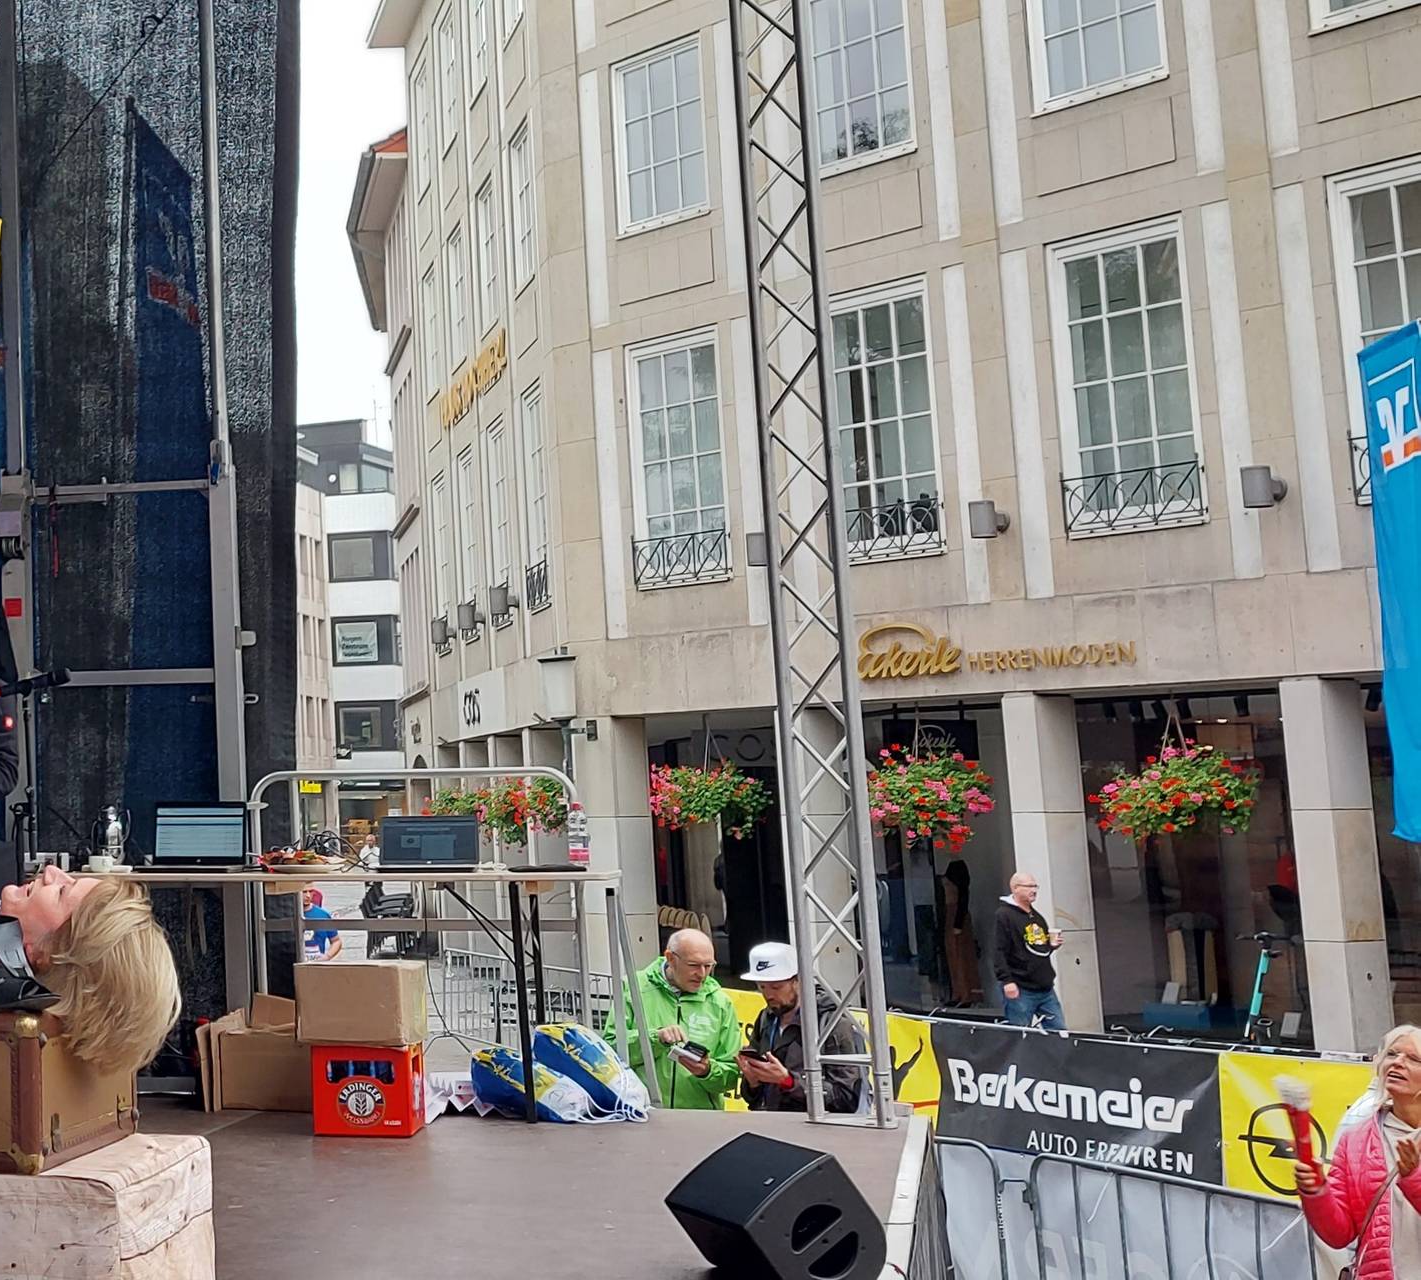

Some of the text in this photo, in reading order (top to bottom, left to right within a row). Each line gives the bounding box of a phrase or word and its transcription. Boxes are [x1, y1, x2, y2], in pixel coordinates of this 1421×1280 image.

[966, 640, 1138, 674] HERRENMODEN
[339, 1082, 383, 1103] ERDINGER
[947, 1057, 1195, 1134] Berkemeier
[1026, 1129, 1195, 1176] AUTO ERFAHREN
